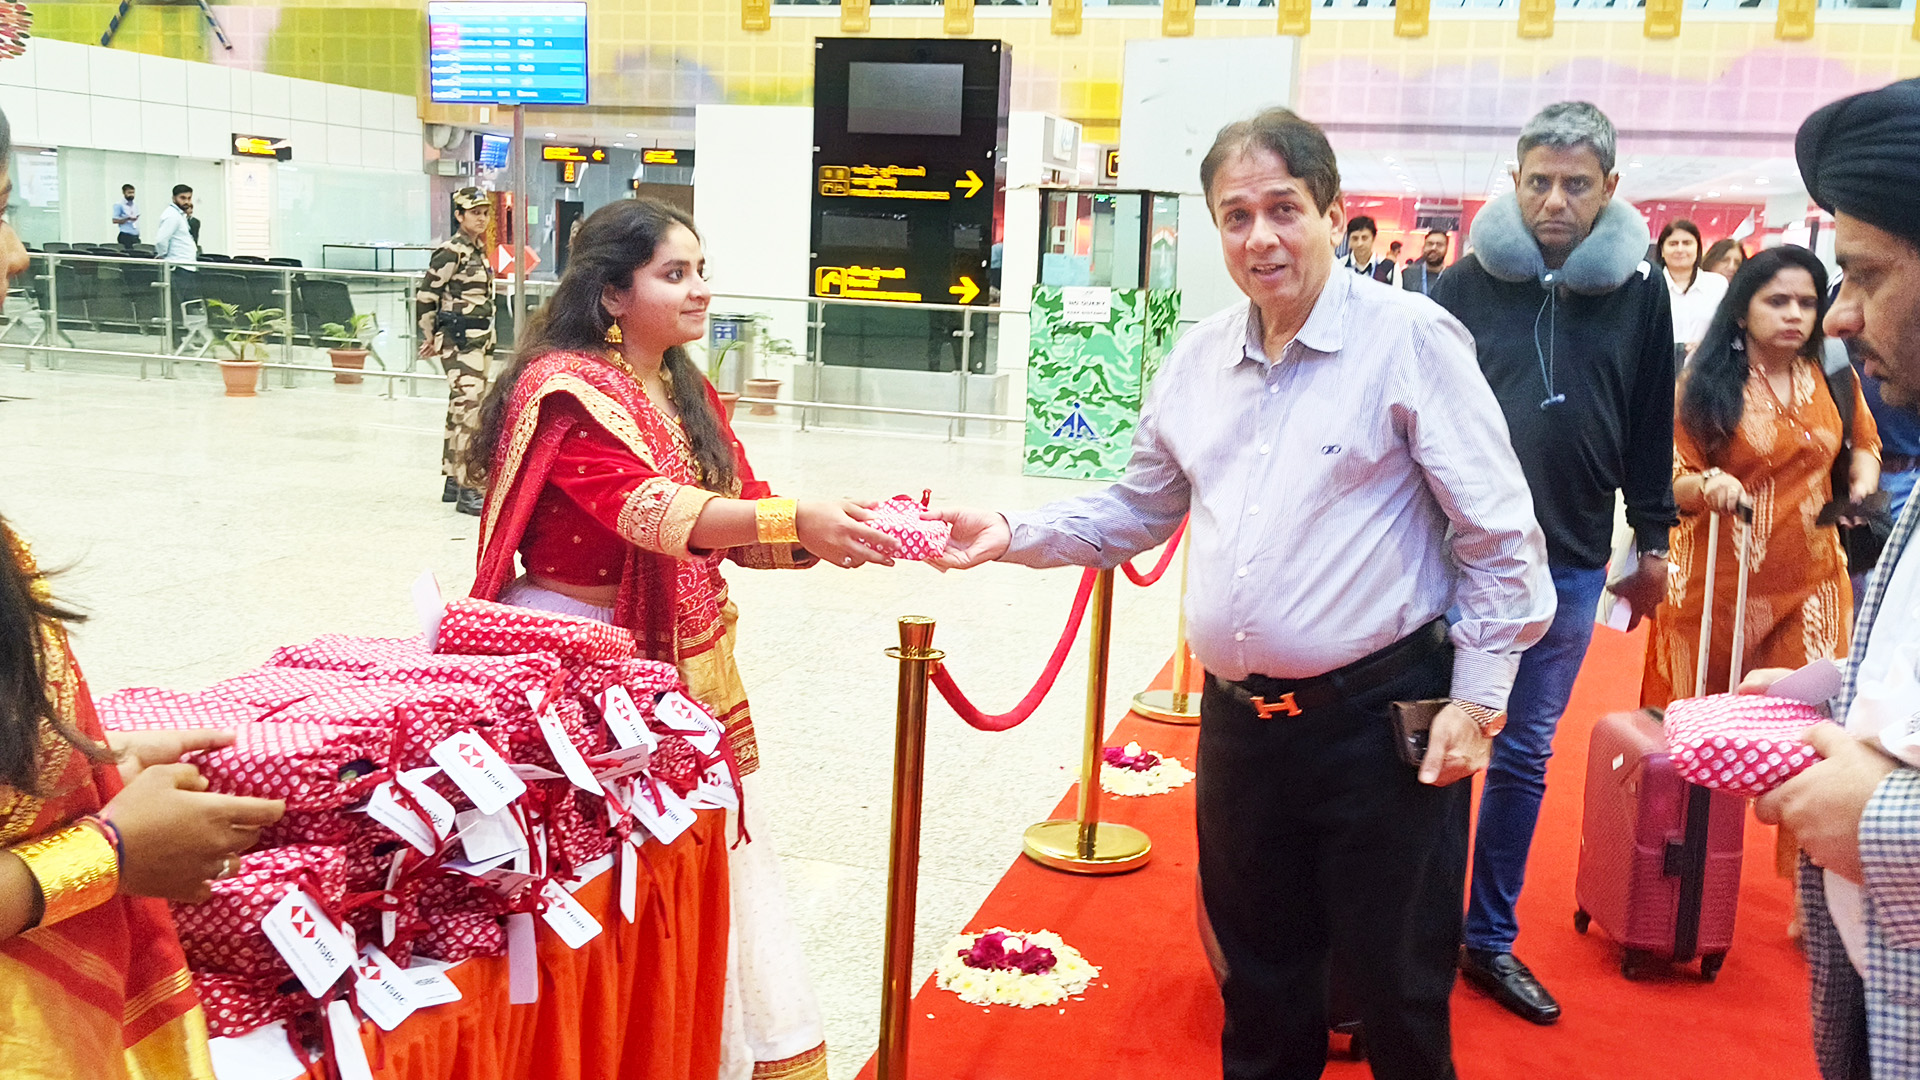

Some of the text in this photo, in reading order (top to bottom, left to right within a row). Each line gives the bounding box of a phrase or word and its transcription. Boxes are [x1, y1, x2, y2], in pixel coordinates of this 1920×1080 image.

[484, 769, 508, 793] HSBC
[314, 937, 339, 968] HSBC
[381, 980, 408, 1006] HSBC
